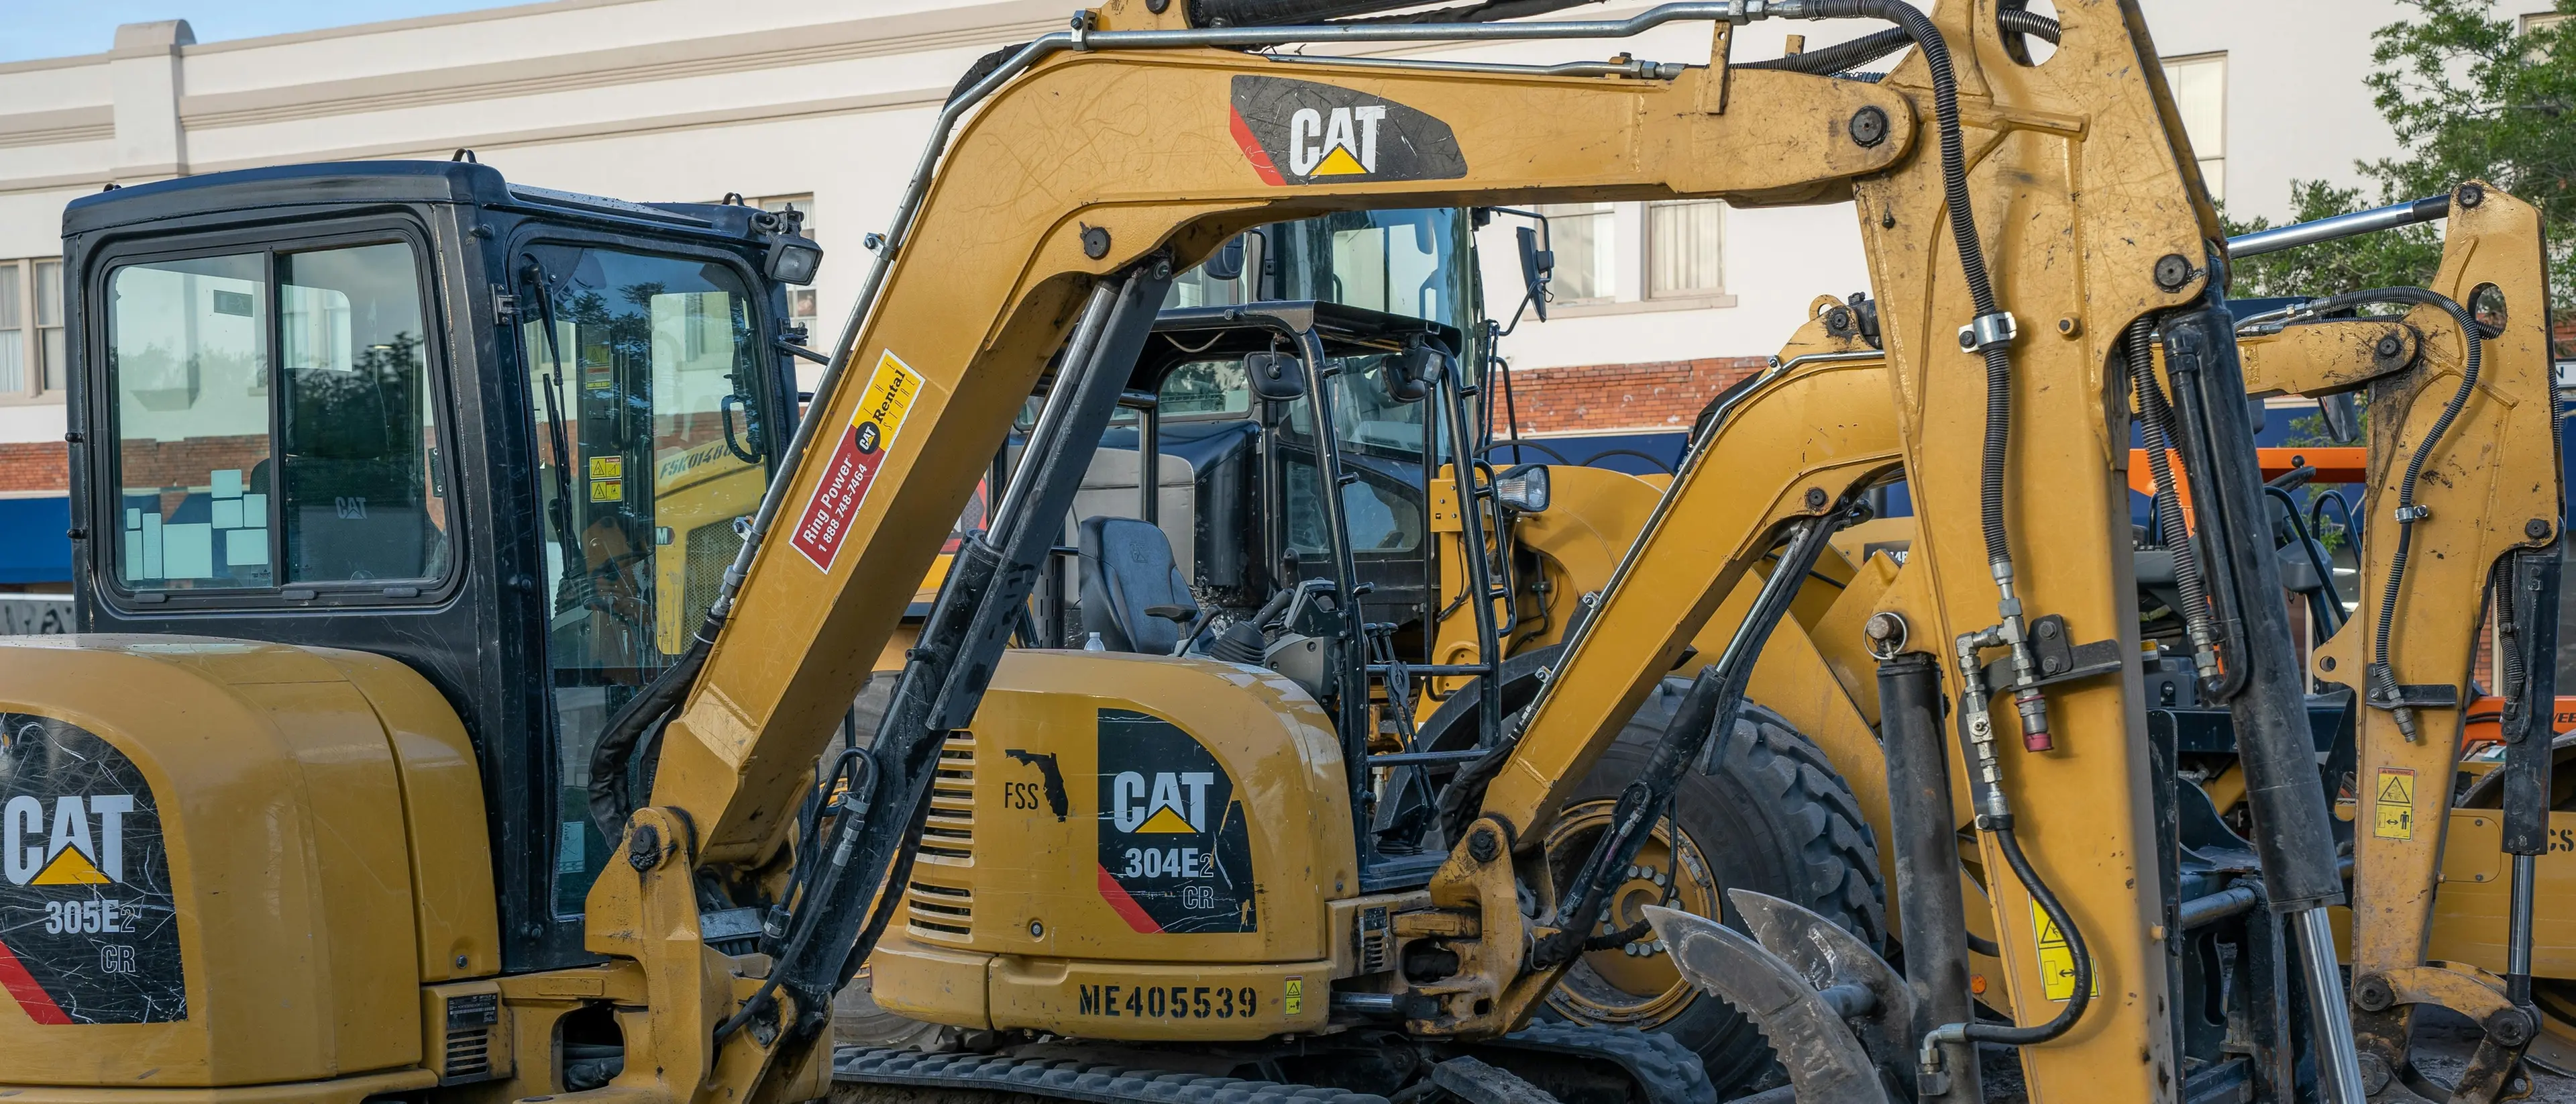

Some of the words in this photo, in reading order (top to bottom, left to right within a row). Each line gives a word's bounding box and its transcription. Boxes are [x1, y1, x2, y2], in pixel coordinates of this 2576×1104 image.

[1290, 105, 1385, 176] CAT
[859, 426, 876, 450] CAT
[873, 369, 905, 423] Rental
[883, 377, 915, 431] STORE
[335, 497, 368, 519] CAT
[802, 509, 830, 544] Ring
[1005, 782, 1038, 809] FSS
[1114, 771, 1214, 833] CAT
[4, 795, 134, 885] CAT
[1125, 848, 1214, 878] 304E2
[1183, 886, 1214, 909] CR
[45, 900, 136, 934] 305E2
[101, 945, 136, 972] CR
[1080, 985, 1256, 1018] ME405539
